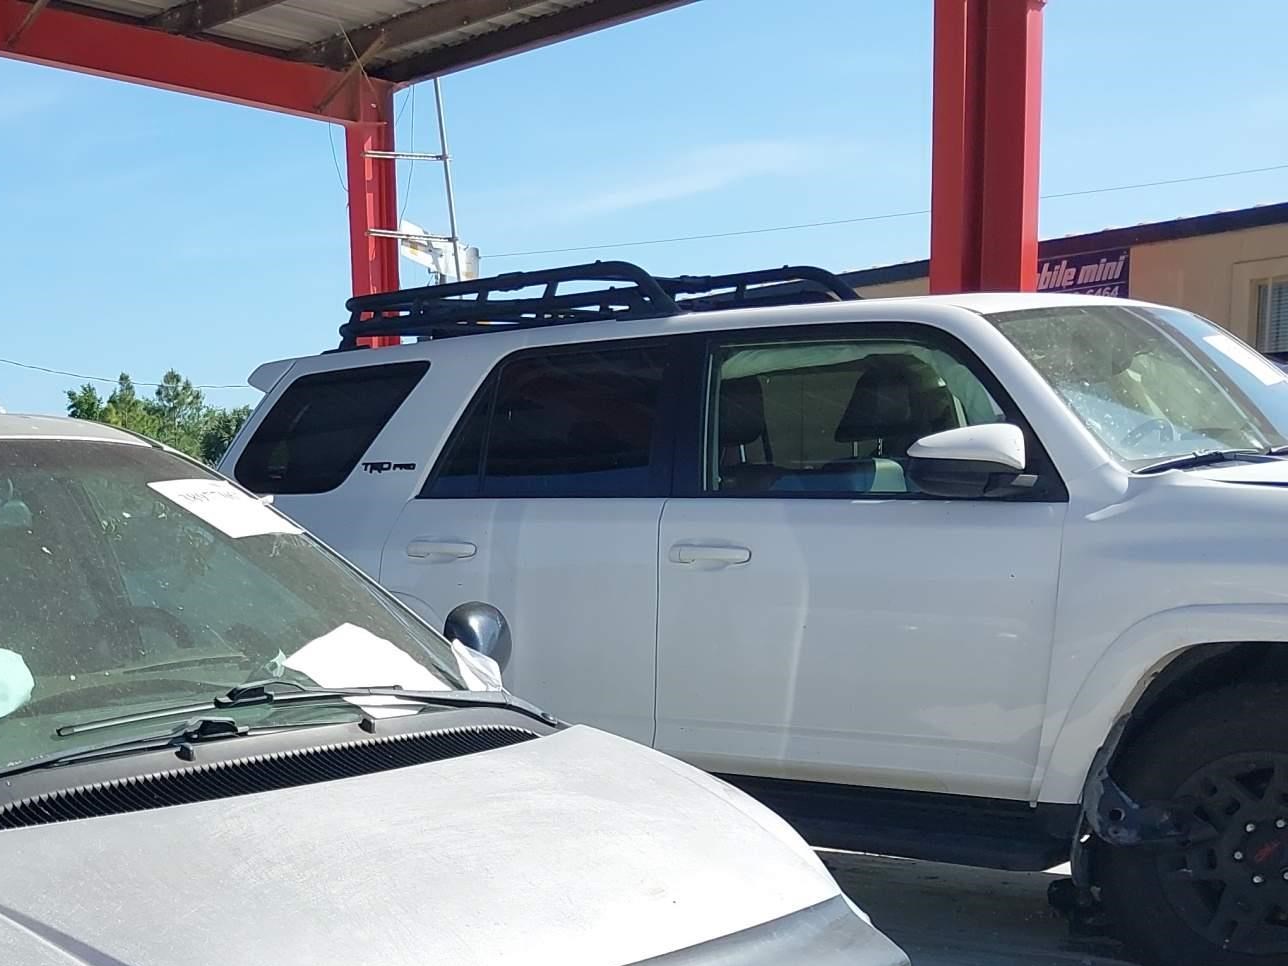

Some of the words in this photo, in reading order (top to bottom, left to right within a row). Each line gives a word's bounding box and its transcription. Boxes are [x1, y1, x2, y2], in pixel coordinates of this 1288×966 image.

[1077, 256, 1126, 285] mini
[362, 461, 392, 474] TRD
[392, 463, 417, 471] PRO
